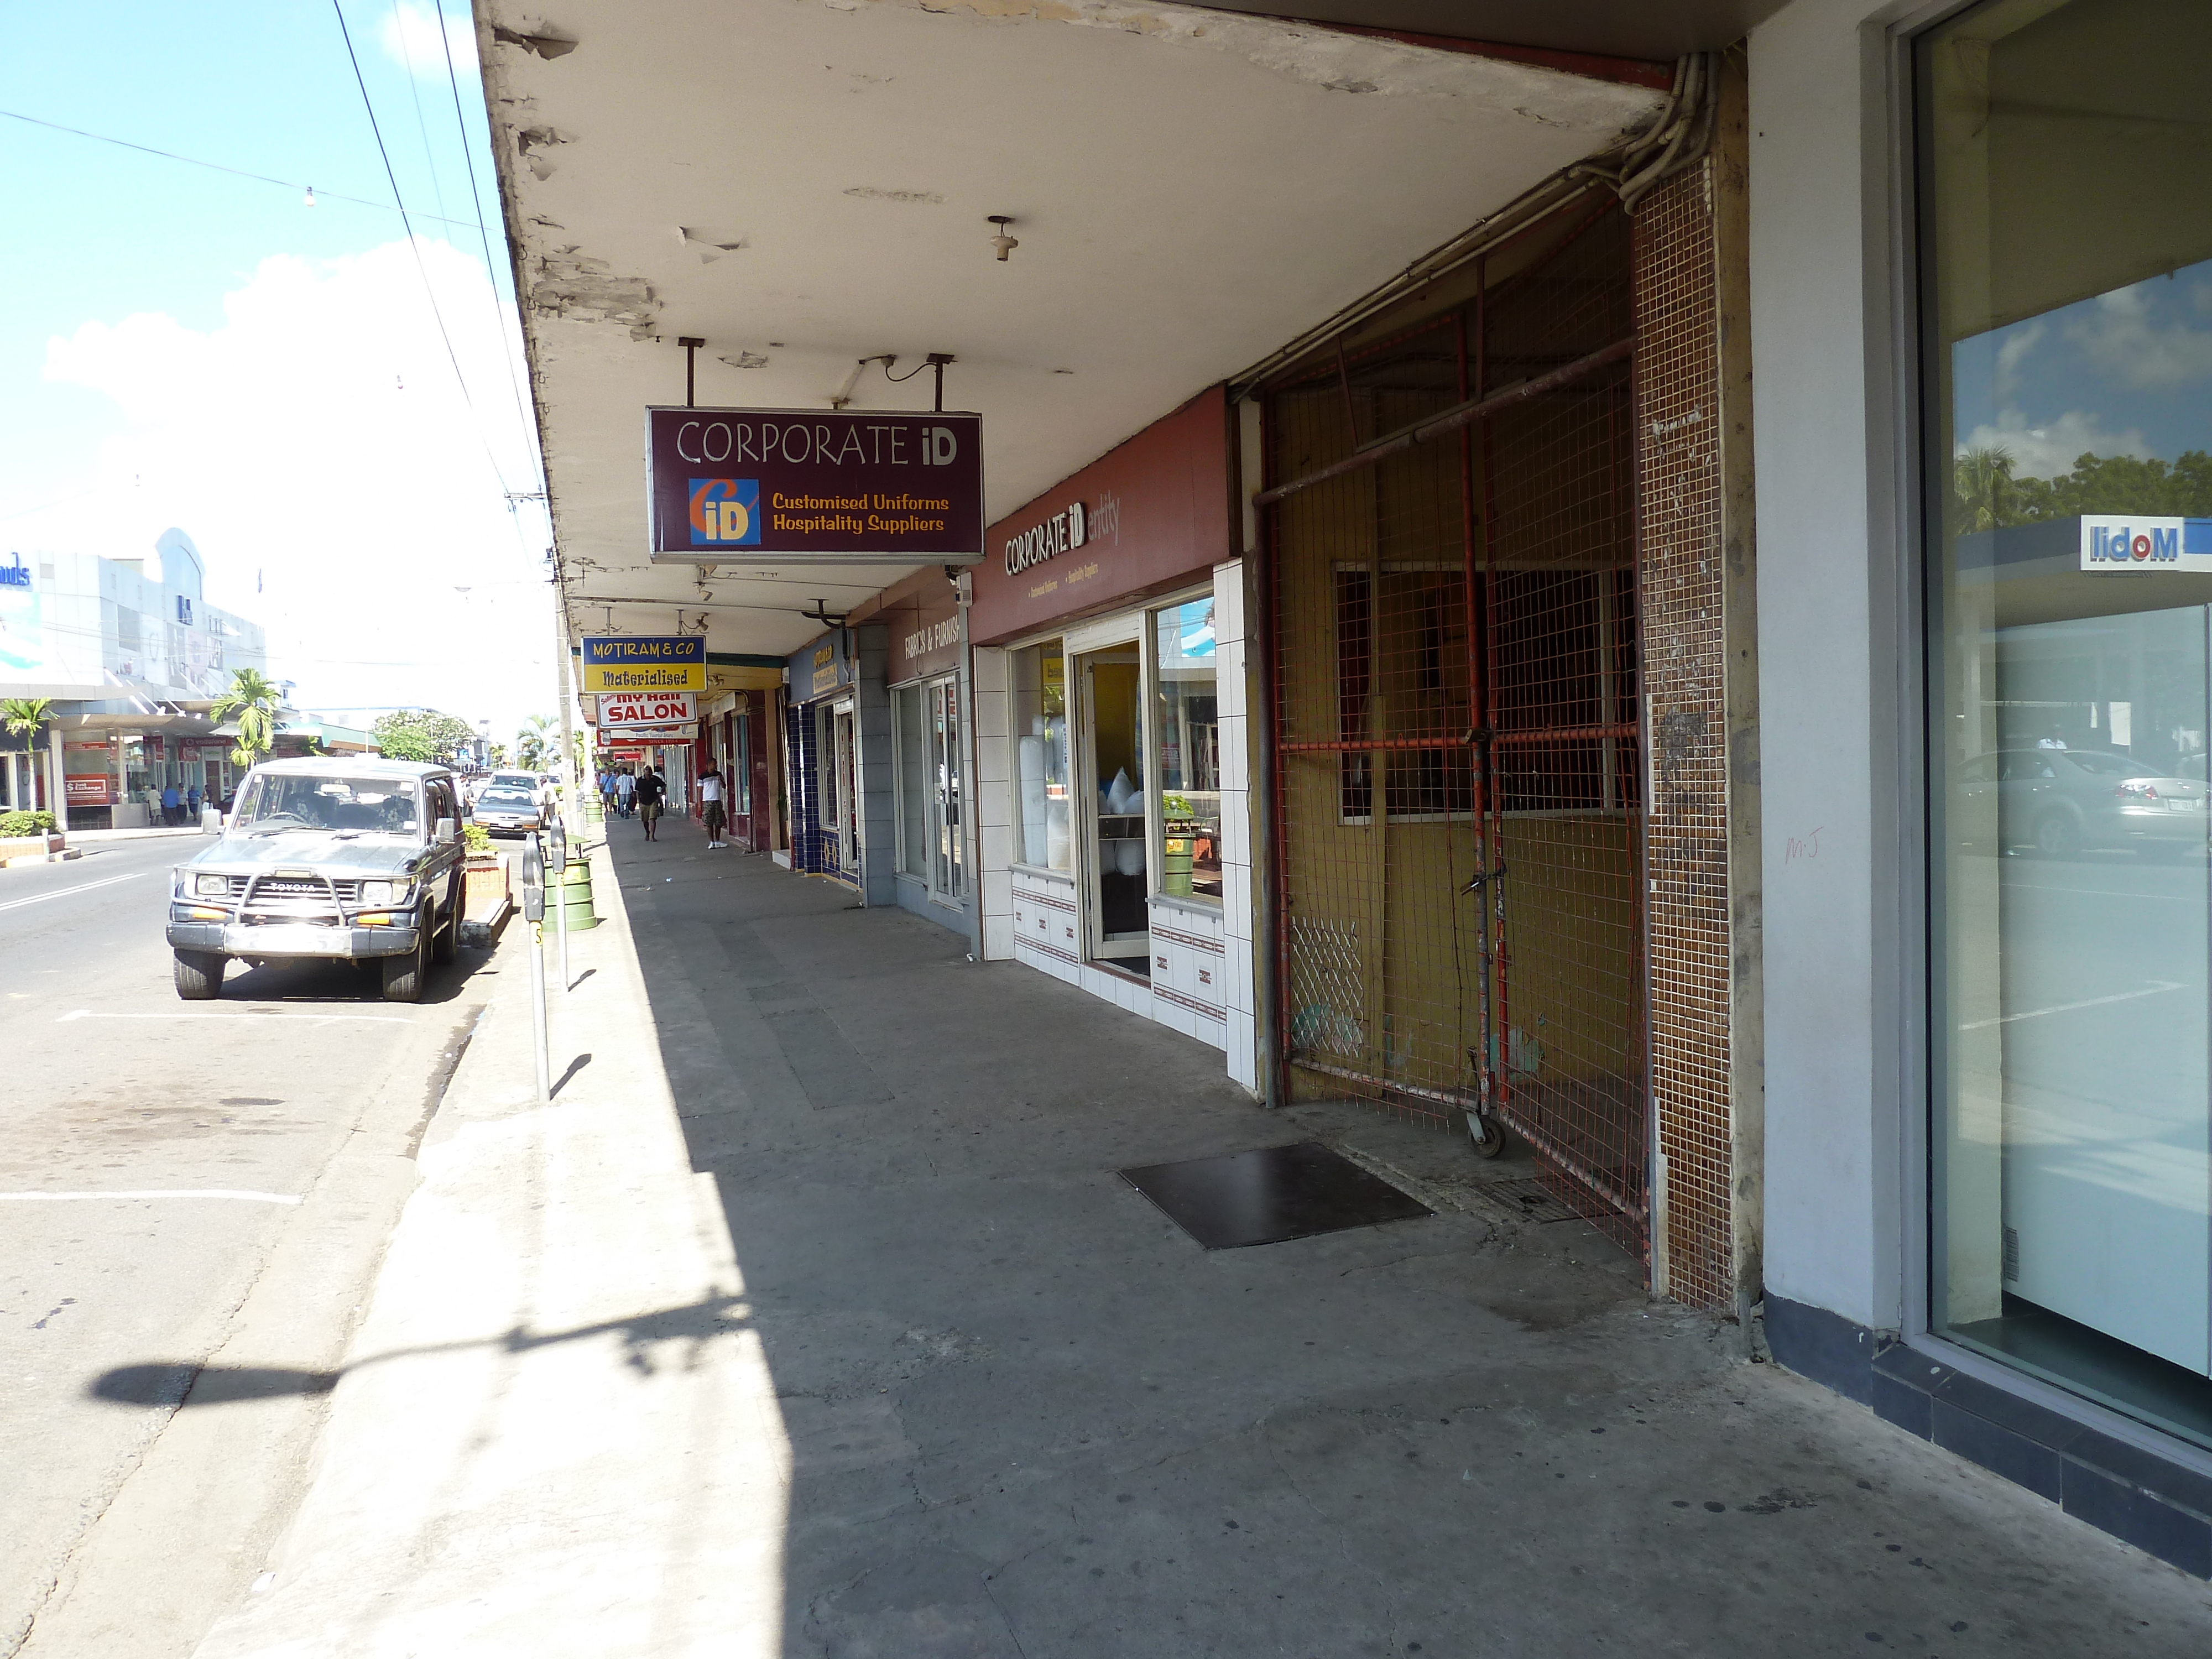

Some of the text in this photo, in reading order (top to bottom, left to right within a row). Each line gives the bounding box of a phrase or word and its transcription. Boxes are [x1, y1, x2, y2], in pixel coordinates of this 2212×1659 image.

[677, 421, 957, 465] CORPORATE iD
[773, 493, 950, 510] Customised Uniforms
[773, 514, 944, 535] Hospitality Suppliers
[1005, 512, 1067, 576] CORPORATE
[1088, 489, 1120, 546] entity
[928, 626, 932, 651] &
[593, 643, 660, 658] MOTIRAM
[608, 703, 687, 722] SALON
[270, 883, 316, 892] TOYOTA
